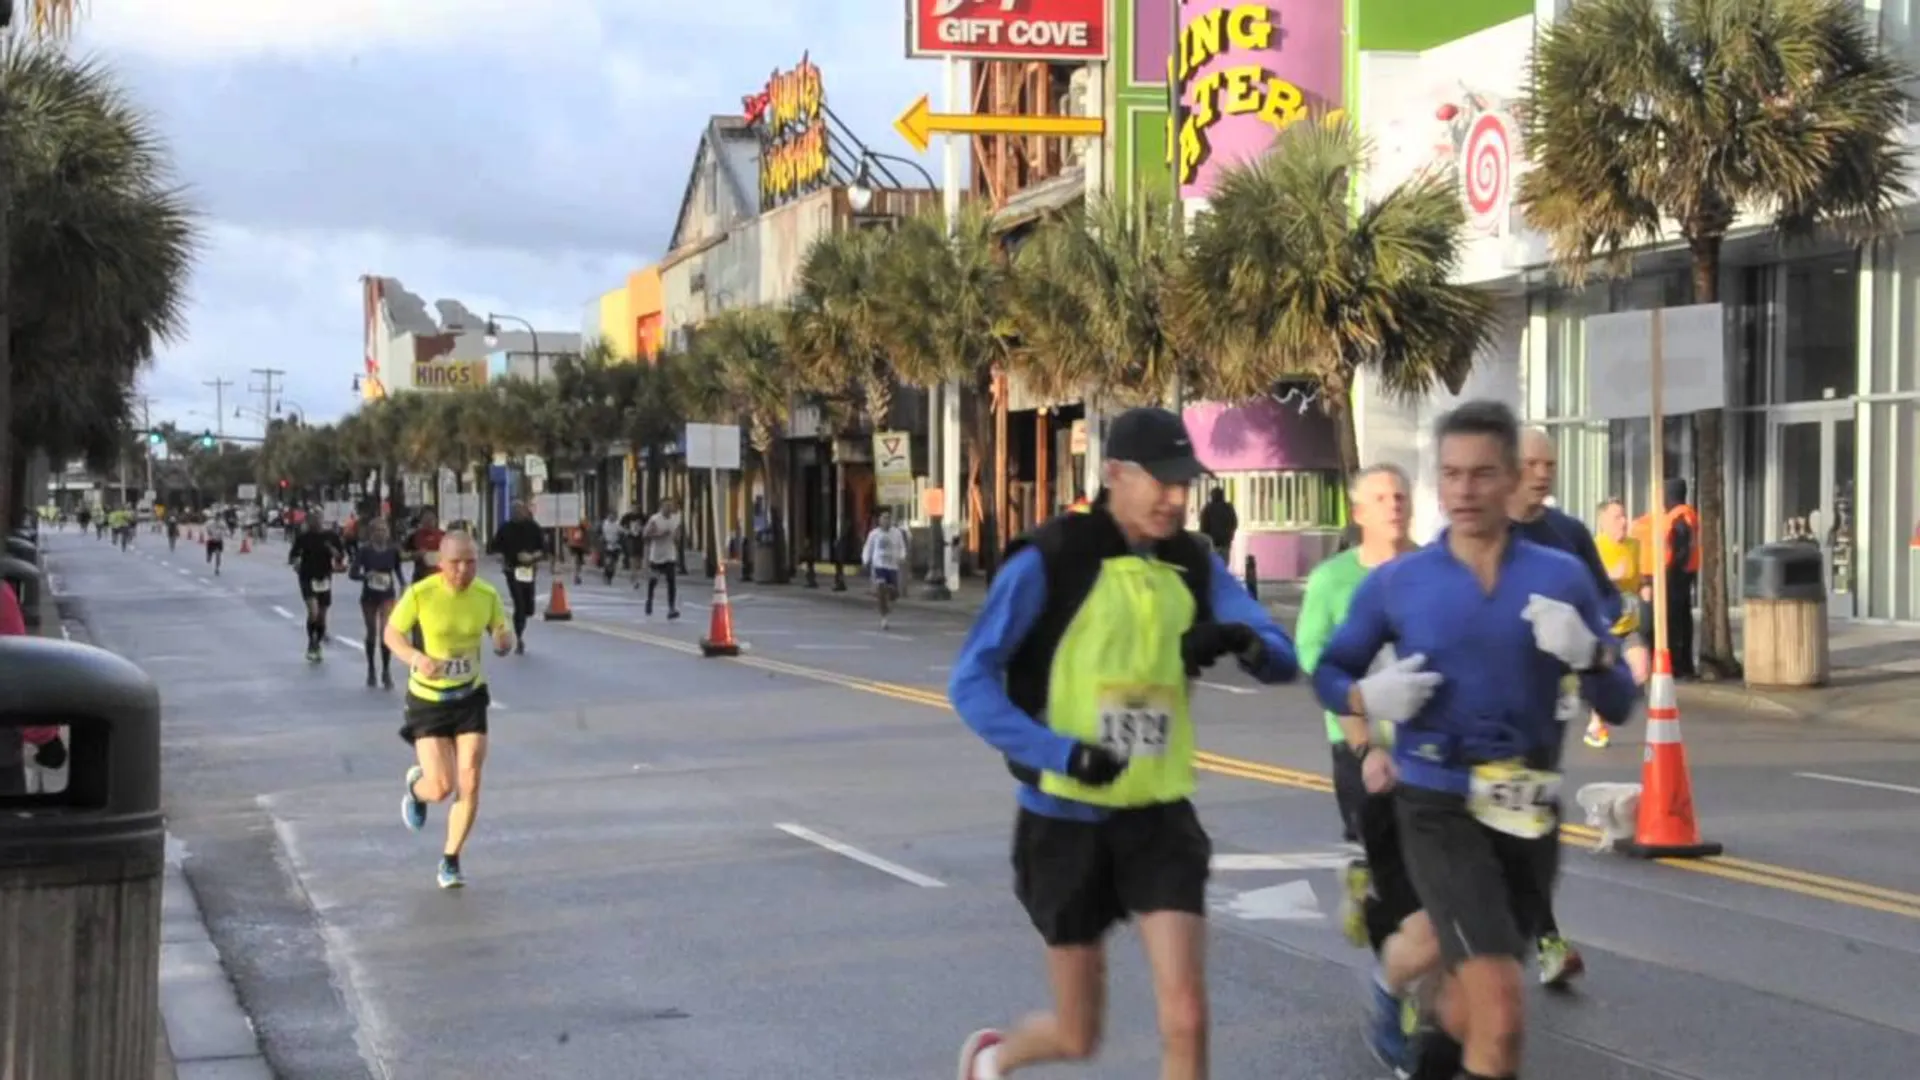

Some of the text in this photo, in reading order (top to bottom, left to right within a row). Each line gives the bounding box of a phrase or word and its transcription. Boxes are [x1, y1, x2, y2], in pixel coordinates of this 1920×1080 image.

[937, 18, 1088, 46] GIFT COVE
[1168, 4, 1272, 86] ING
[1166, 64, 1308, 185] ATER
